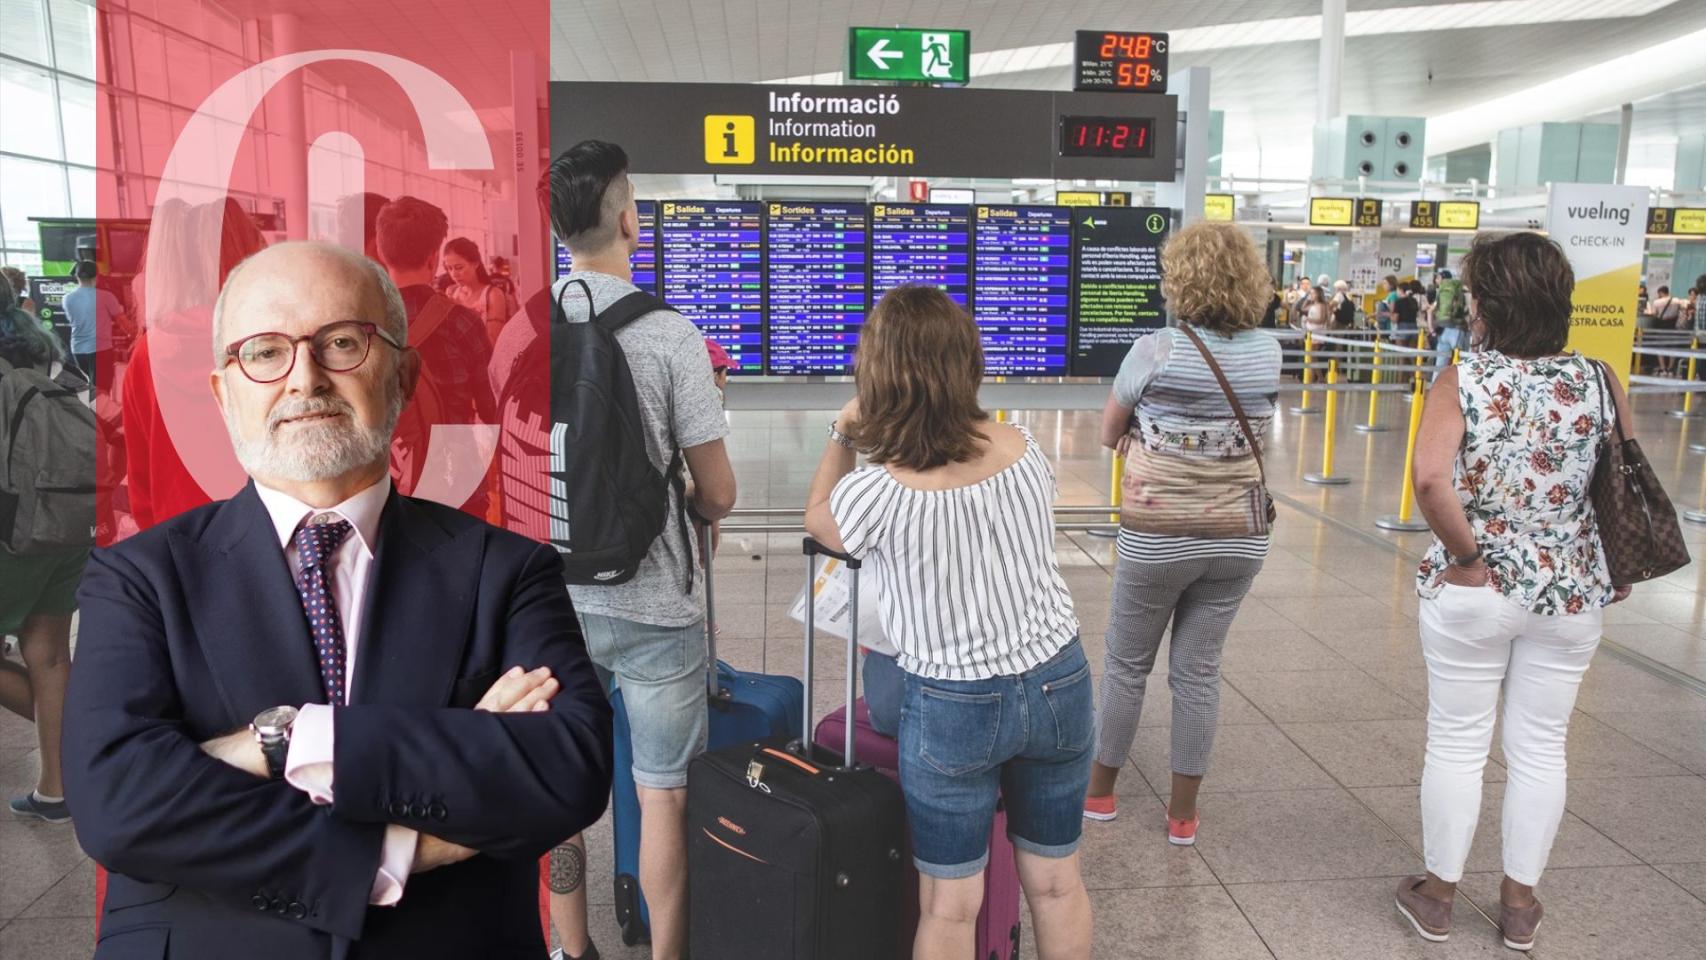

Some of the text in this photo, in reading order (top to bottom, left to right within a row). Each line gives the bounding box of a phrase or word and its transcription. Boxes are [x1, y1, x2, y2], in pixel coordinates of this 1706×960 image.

[1118, 63, 1151, 86] 59
[769, 91, 900, 115] Informació
[769, 118, 876, 138] Information
[1079, 126, 1147, 149] 11:21
[769, 142, 914, 164] Información
[676, 205, 705, 213] Salidas
[782, 206, 815, 214] Sortides
[886, 207, 915, 216] Salidas
[990, 209, 1018, 217] Salidas
[1568, 201, 1630, 225] vueling
[1358, 215, 1379, 225] 454
[1412, 216, 1433, 226] 455
[1649, 223, 1668, 232] 457
[1570, 235, 1626, 247] CHECK-IN
[1571, 304, 1625, 314] NVENIDO A
[1570, 317, 1624, 327] ESTRA CASA
[501, 395, 571, 553] NIKE
